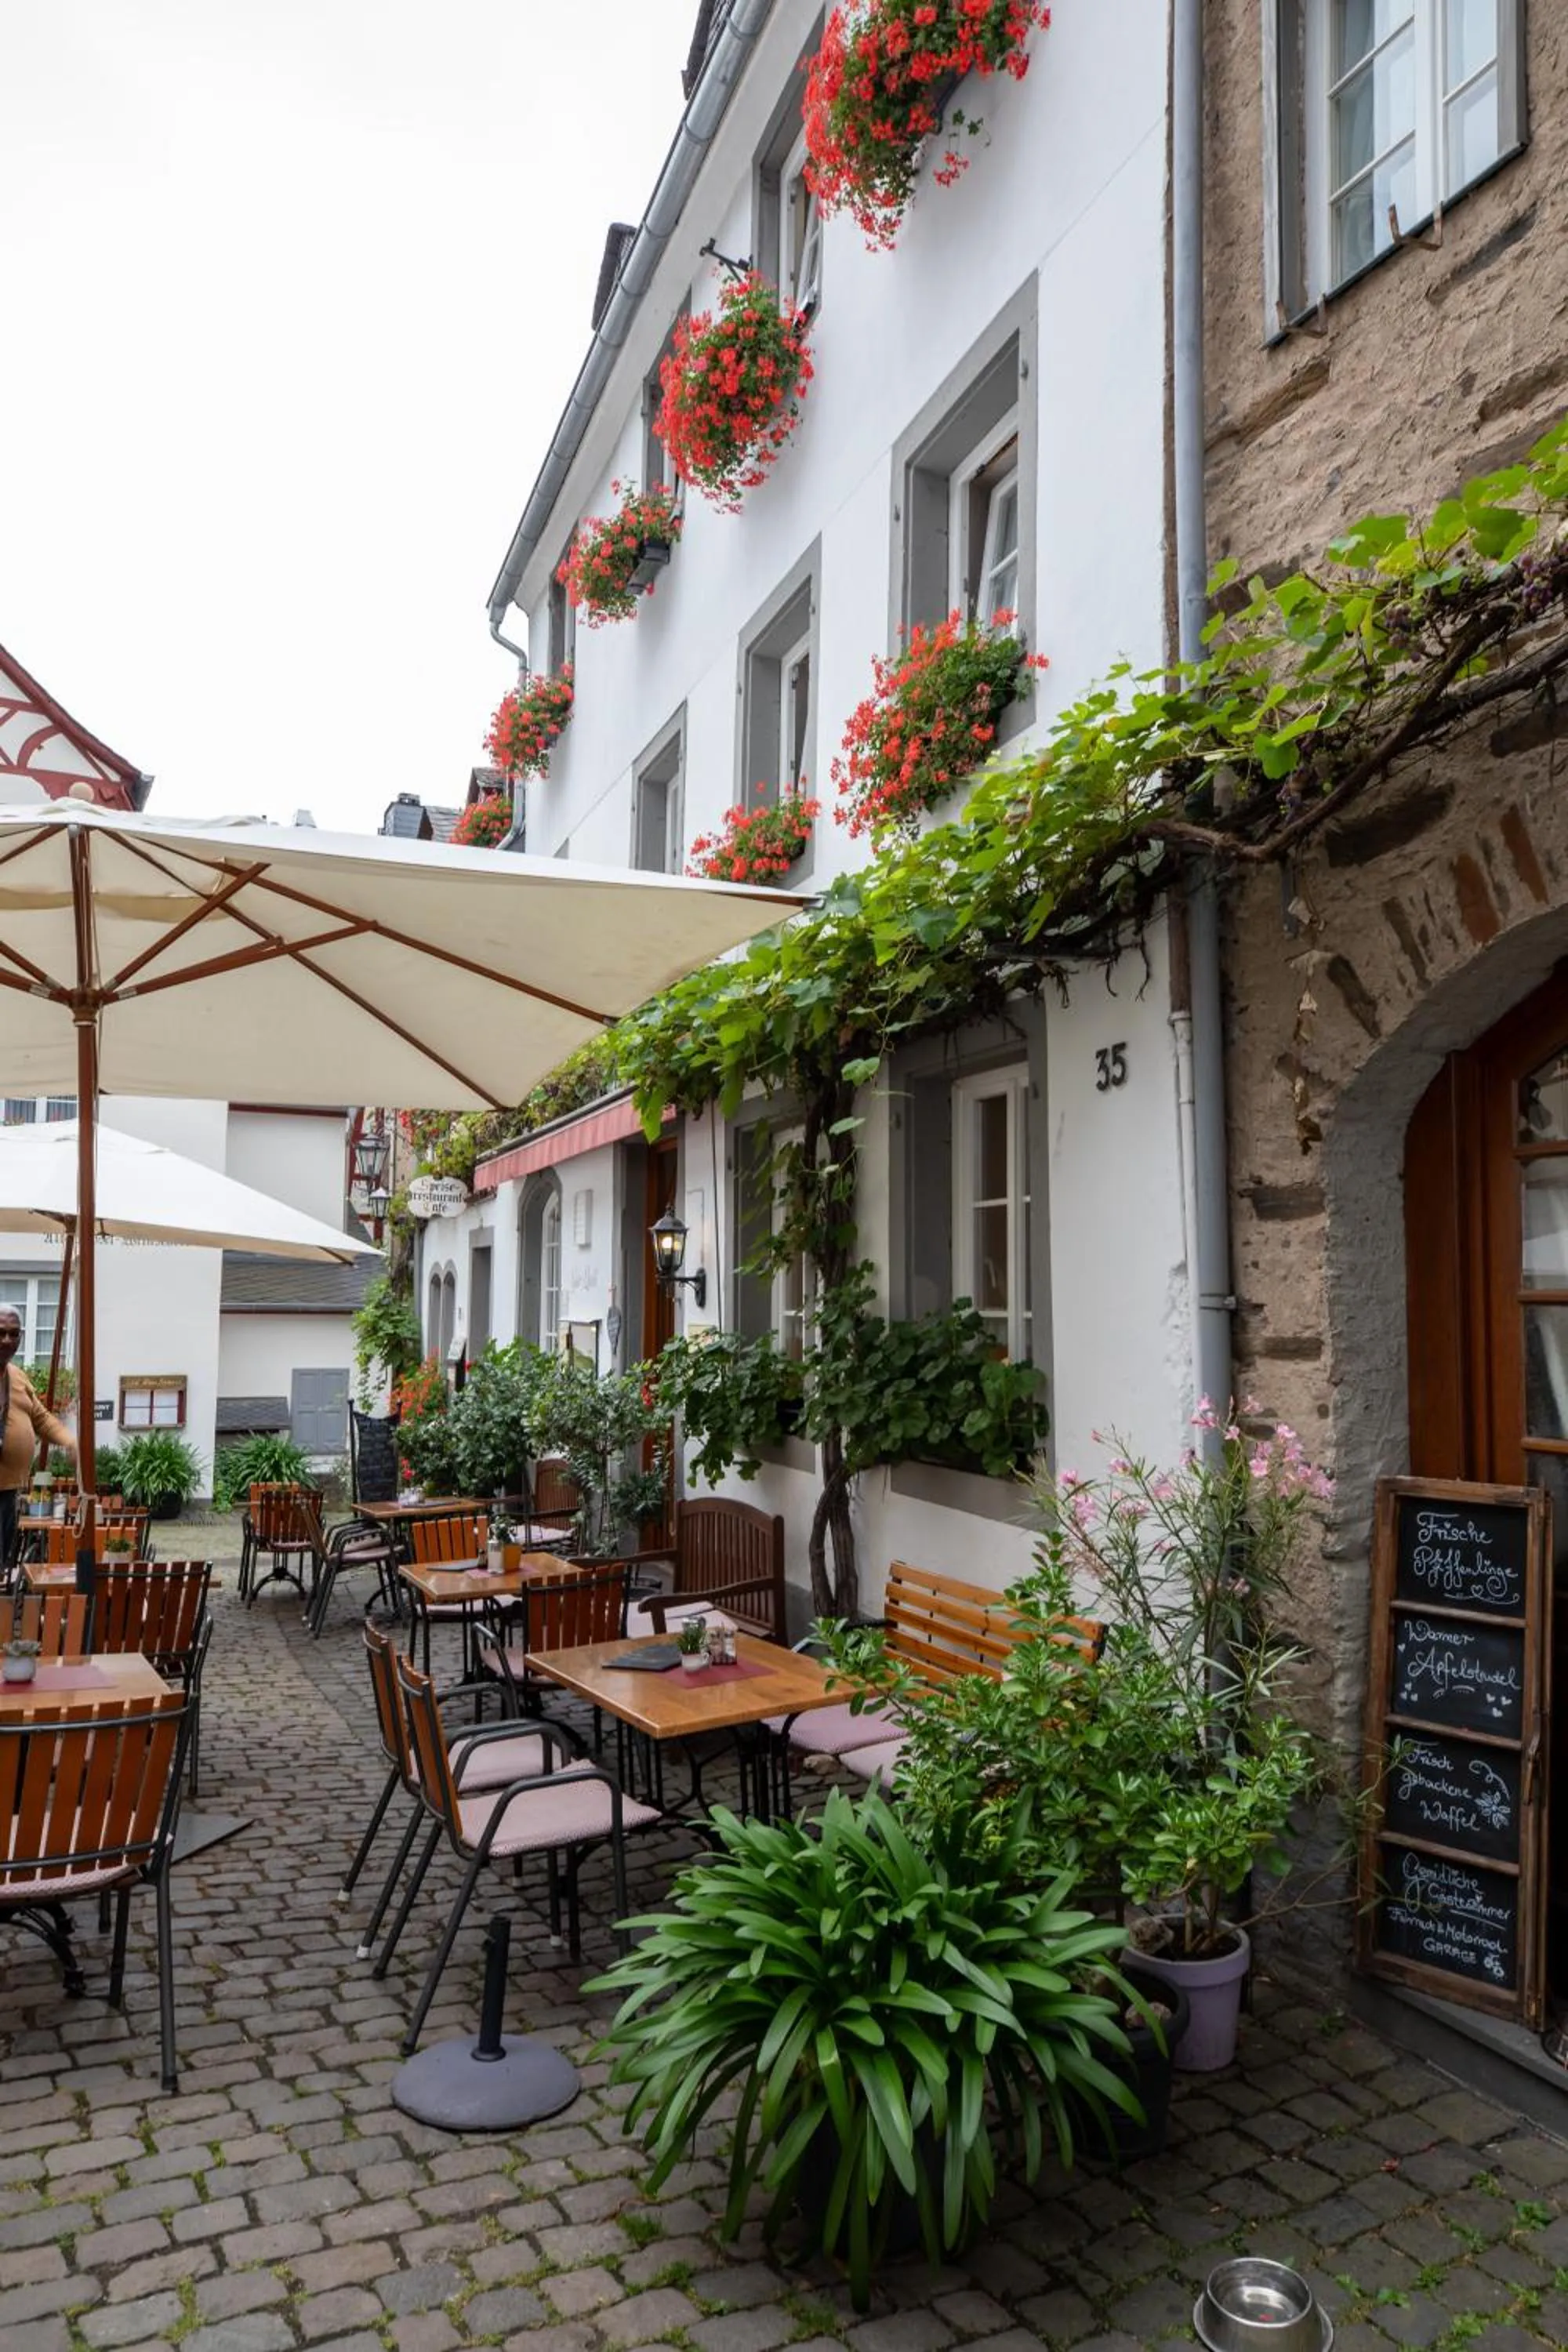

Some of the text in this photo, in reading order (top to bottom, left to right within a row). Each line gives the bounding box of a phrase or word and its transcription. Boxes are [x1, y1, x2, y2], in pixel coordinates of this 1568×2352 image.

[1095, 1041, 1127, 1091] 35
[1416, 1511, 1494, 1544] Frische
[1404, 1620, 1475, 1646] Warmer
[1406, 1646, 1522, 1691] Apfelstrudel
[1402, 1738, 1454, 1771] Frisch
[1419, 1799, 1481, 1833] Waffel
[1423, 1937, 1478, 1965] GARAGE
